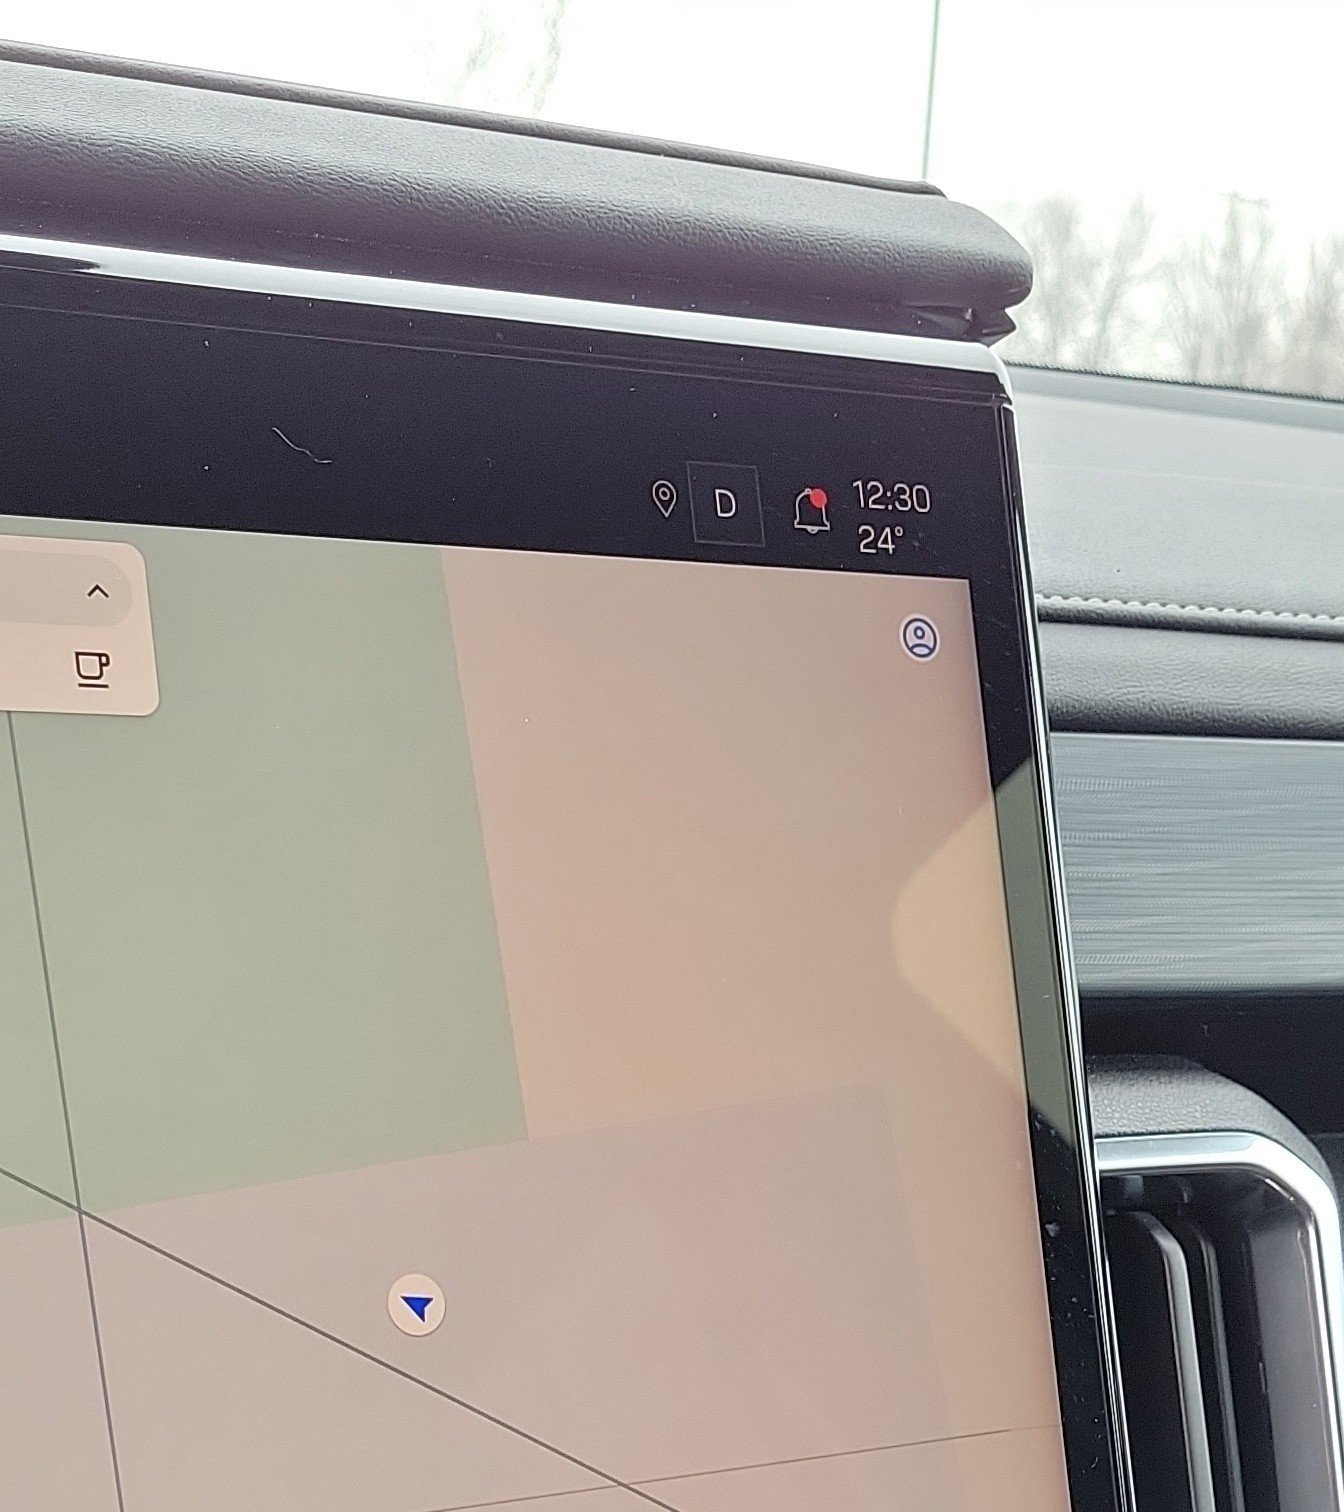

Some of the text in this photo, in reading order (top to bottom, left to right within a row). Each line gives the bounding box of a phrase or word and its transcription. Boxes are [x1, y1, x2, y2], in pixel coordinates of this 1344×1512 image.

[715, 488, 736, 518] D
[852, 480, 931, 513] 12:30
[858, 525, 904, 555] 24°
